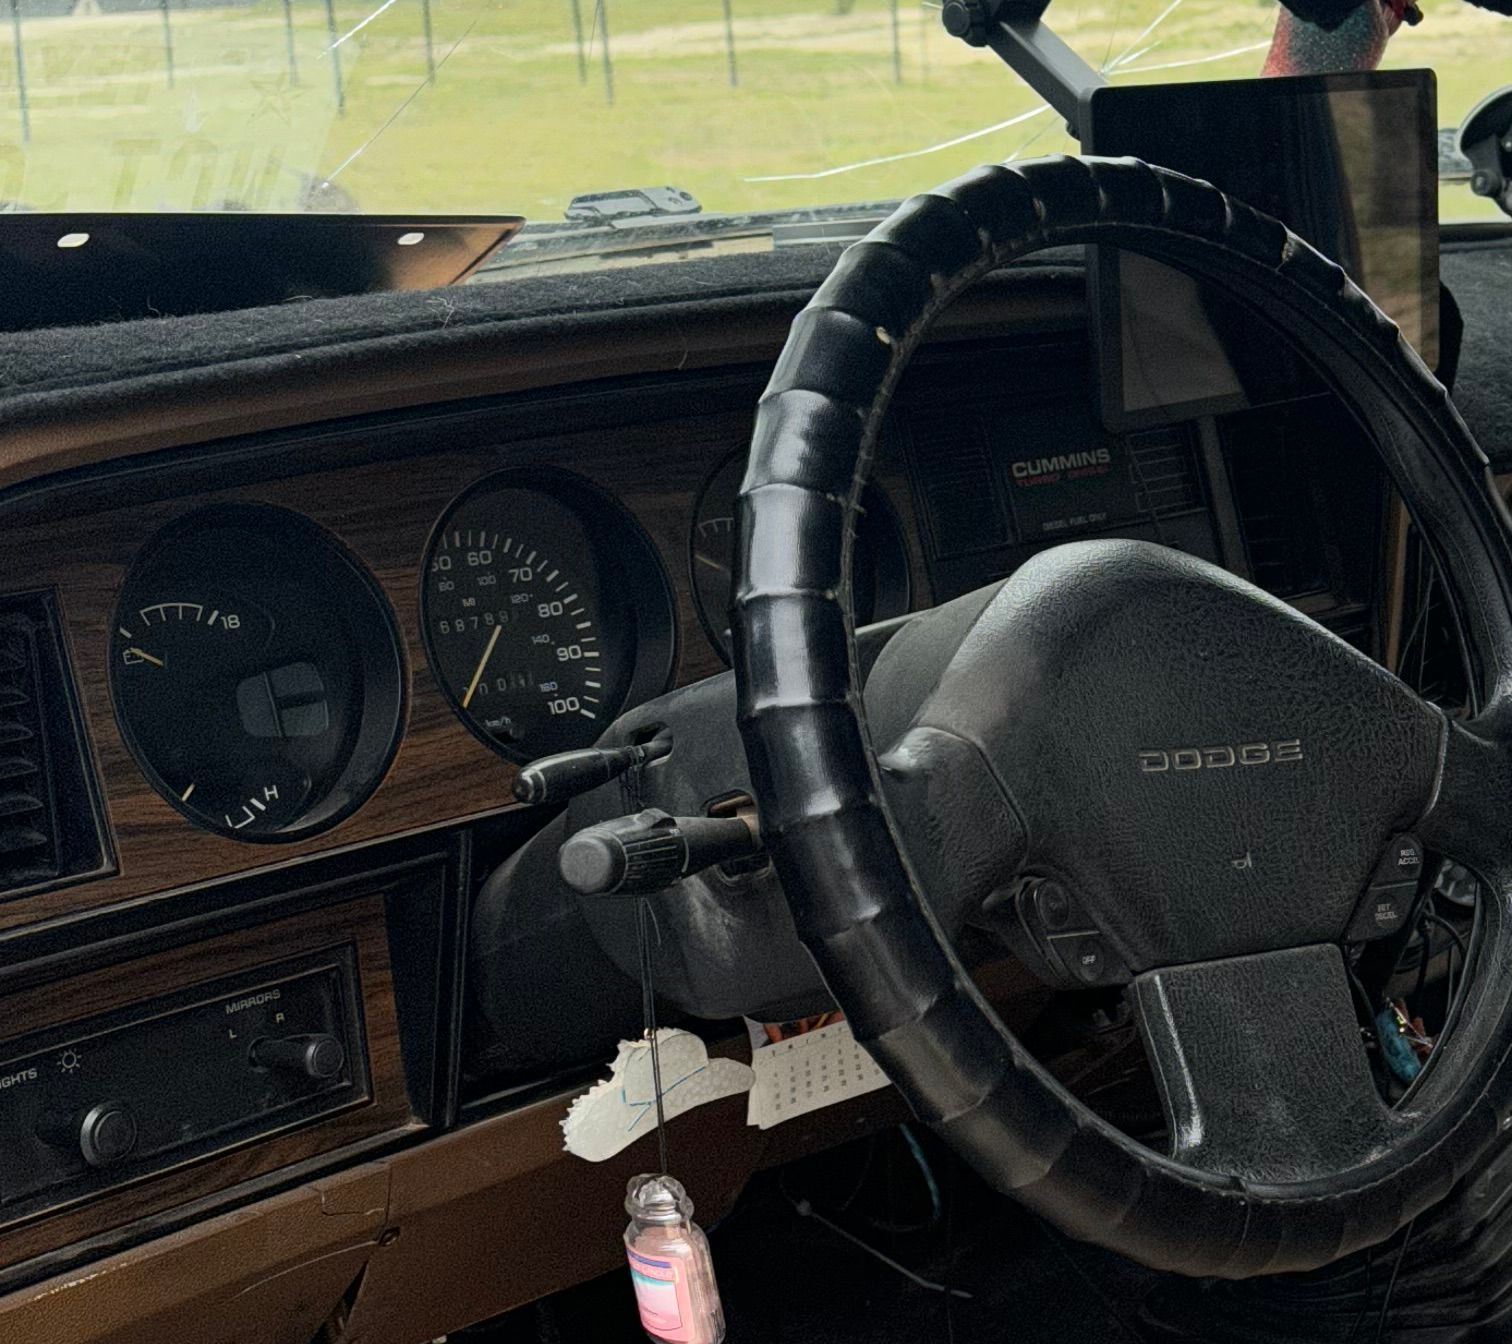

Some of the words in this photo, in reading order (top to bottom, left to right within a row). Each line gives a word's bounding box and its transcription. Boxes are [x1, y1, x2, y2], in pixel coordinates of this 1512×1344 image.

[1012, 448, 1110, 478] CUMMINS
[468, 550, 492, 566] 60
[508, 567, 533, 583] 70
[538, 601, 563, 618] 80
[220, 614, 241, 629] 18
[557, 645, 582, 661] 90
[548, 696, 580, 715] 100
[1138, 739, 1303, 772] DODGE
[264, 785, 279, 800] H
[225, 989, 282, 1015] MIRRORS
[229, 1029, 237, 1039] L
[276, 1012, 285, 1023] R
